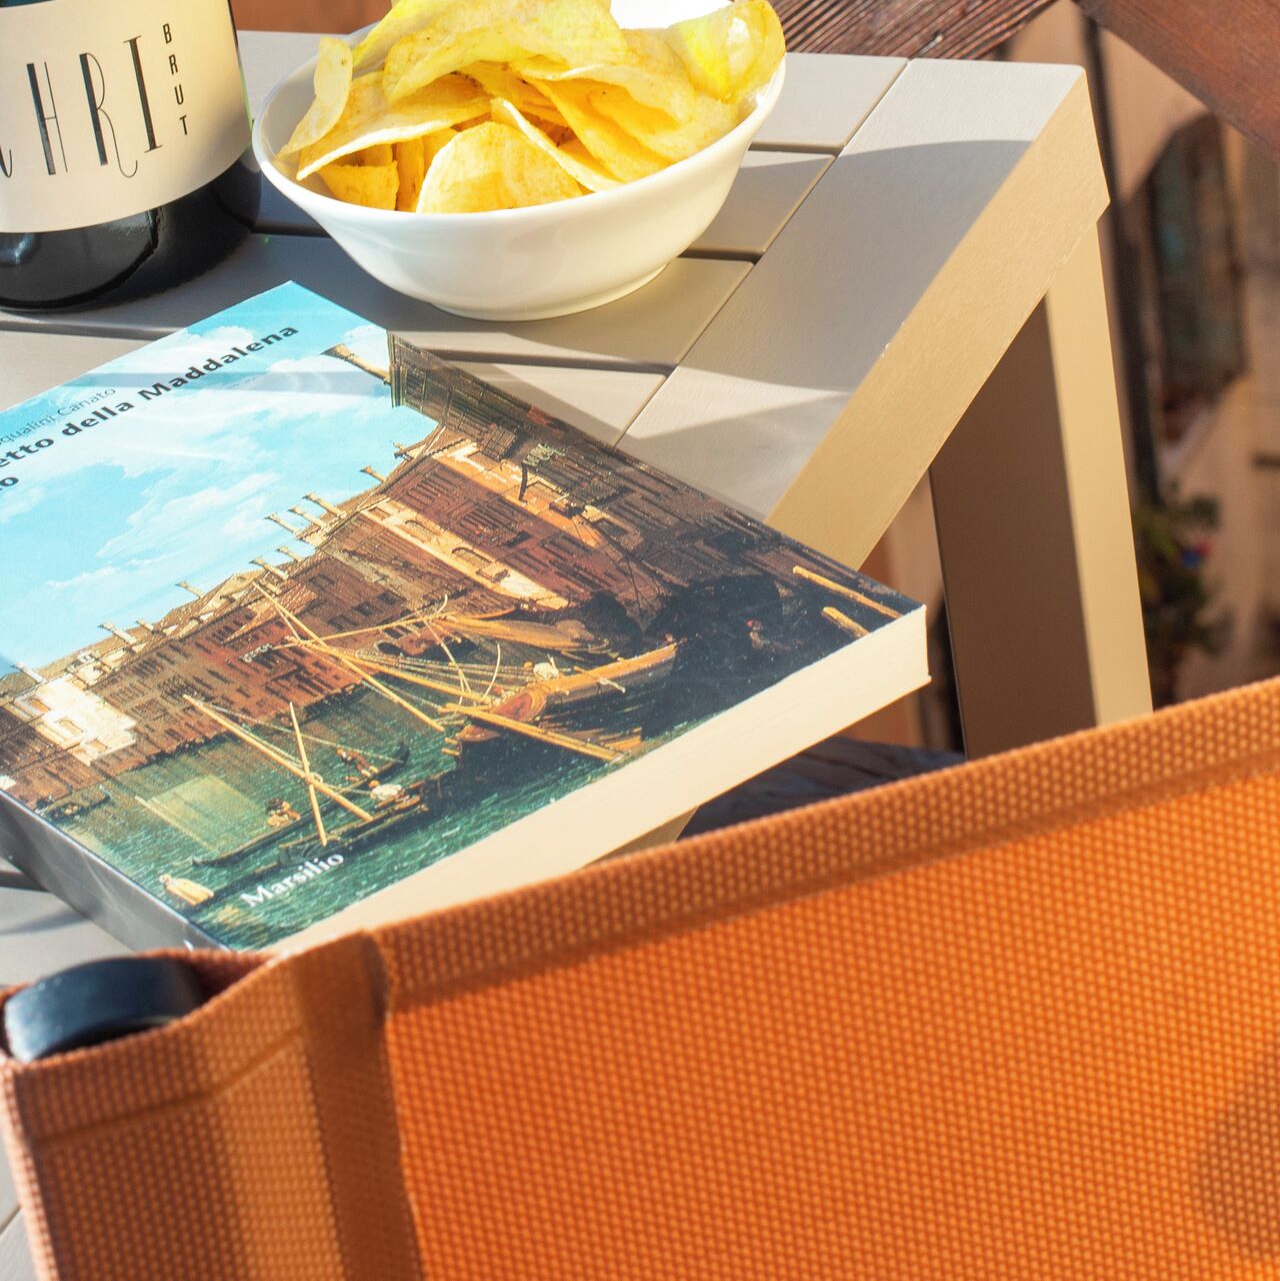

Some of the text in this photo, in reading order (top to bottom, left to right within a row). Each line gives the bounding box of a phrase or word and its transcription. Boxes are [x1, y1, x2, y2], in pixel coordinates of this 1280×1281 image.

[162, 23, 188, 136] BRUT
[57, 388, 116, 417] Canato
[61, 401, 135, 437] della
[138, 325, 300, 401] Maddalena
[240, 853, 345, 908] Marsilio
